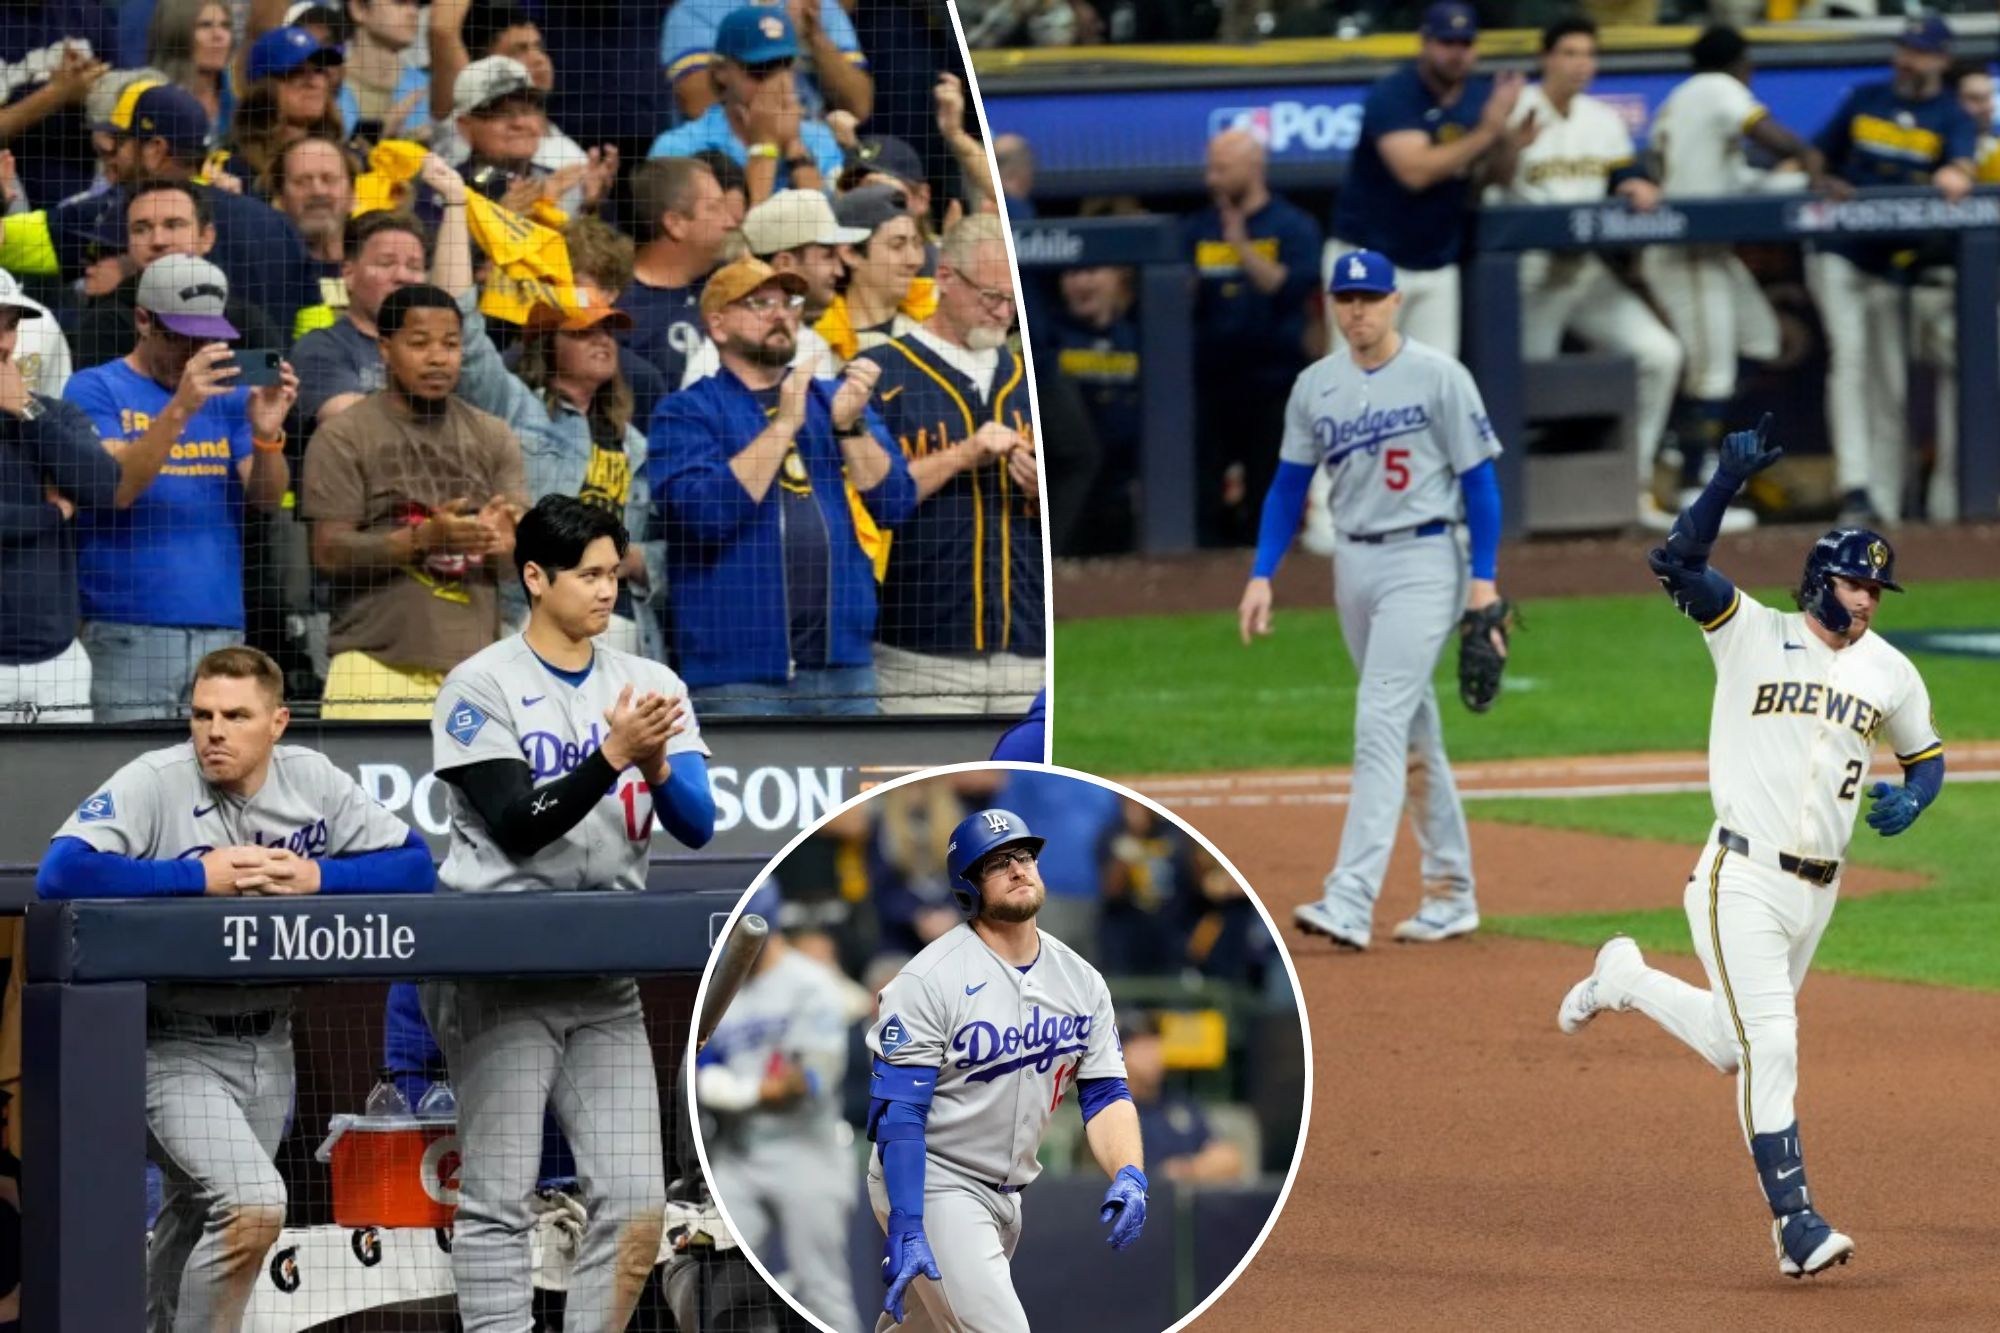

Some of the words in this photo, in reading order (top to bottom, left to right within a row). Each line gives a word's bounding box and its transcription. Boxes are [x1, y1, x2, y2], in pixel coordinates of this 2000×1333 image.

[1314, 404, 1430, 464] Dodgers
[1385, 449, 1410, 492] 5
[1838, 758, 1863, 801] 2
[982, 811, 1010, 834] LA
[269, 913, 416, 961] Mobile
[952, 1005, 1093, 1084] Dodger
